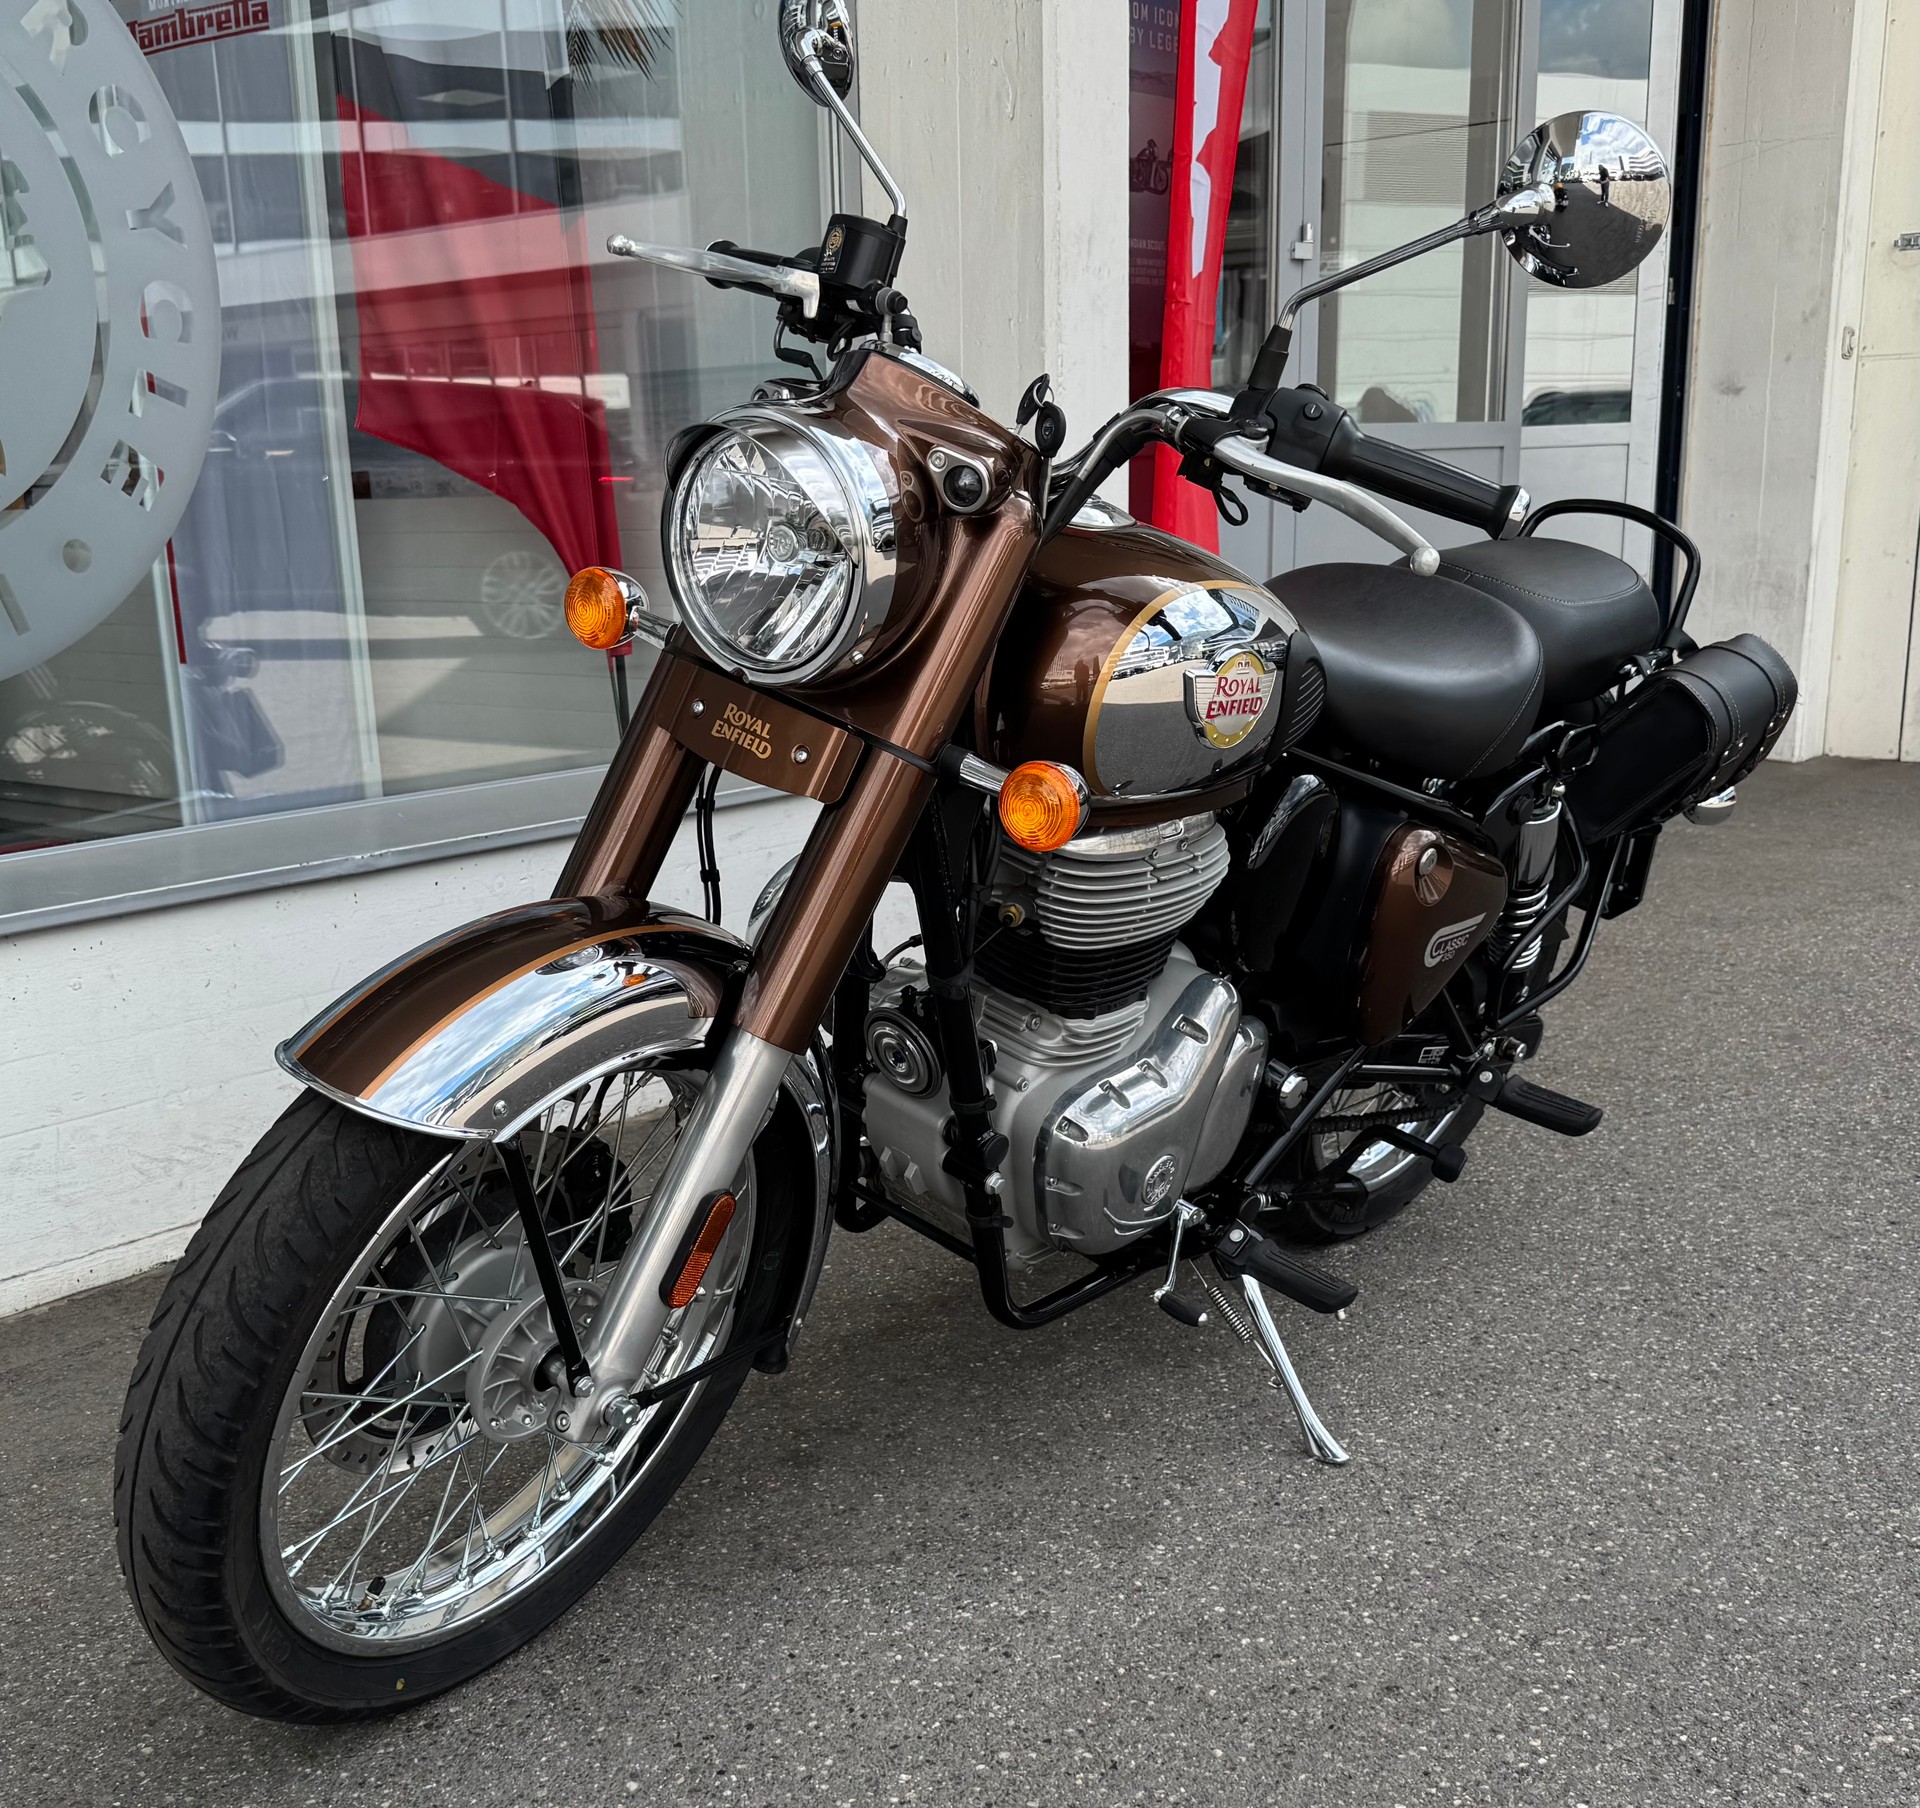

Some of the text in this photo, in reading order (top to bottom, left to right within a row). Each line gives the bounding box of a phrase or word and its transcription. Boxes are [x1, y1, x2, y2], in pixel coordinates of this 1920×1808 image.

[1216, 676, 1261, 697] ROYAL
[723, 702, 771, 739] ROYAL
[1205, 696, 1263, 719] ENFIELD
[710, 719, 772, 759] ENFIELD
[1432, 930, 1471, 957] CLASSIC
